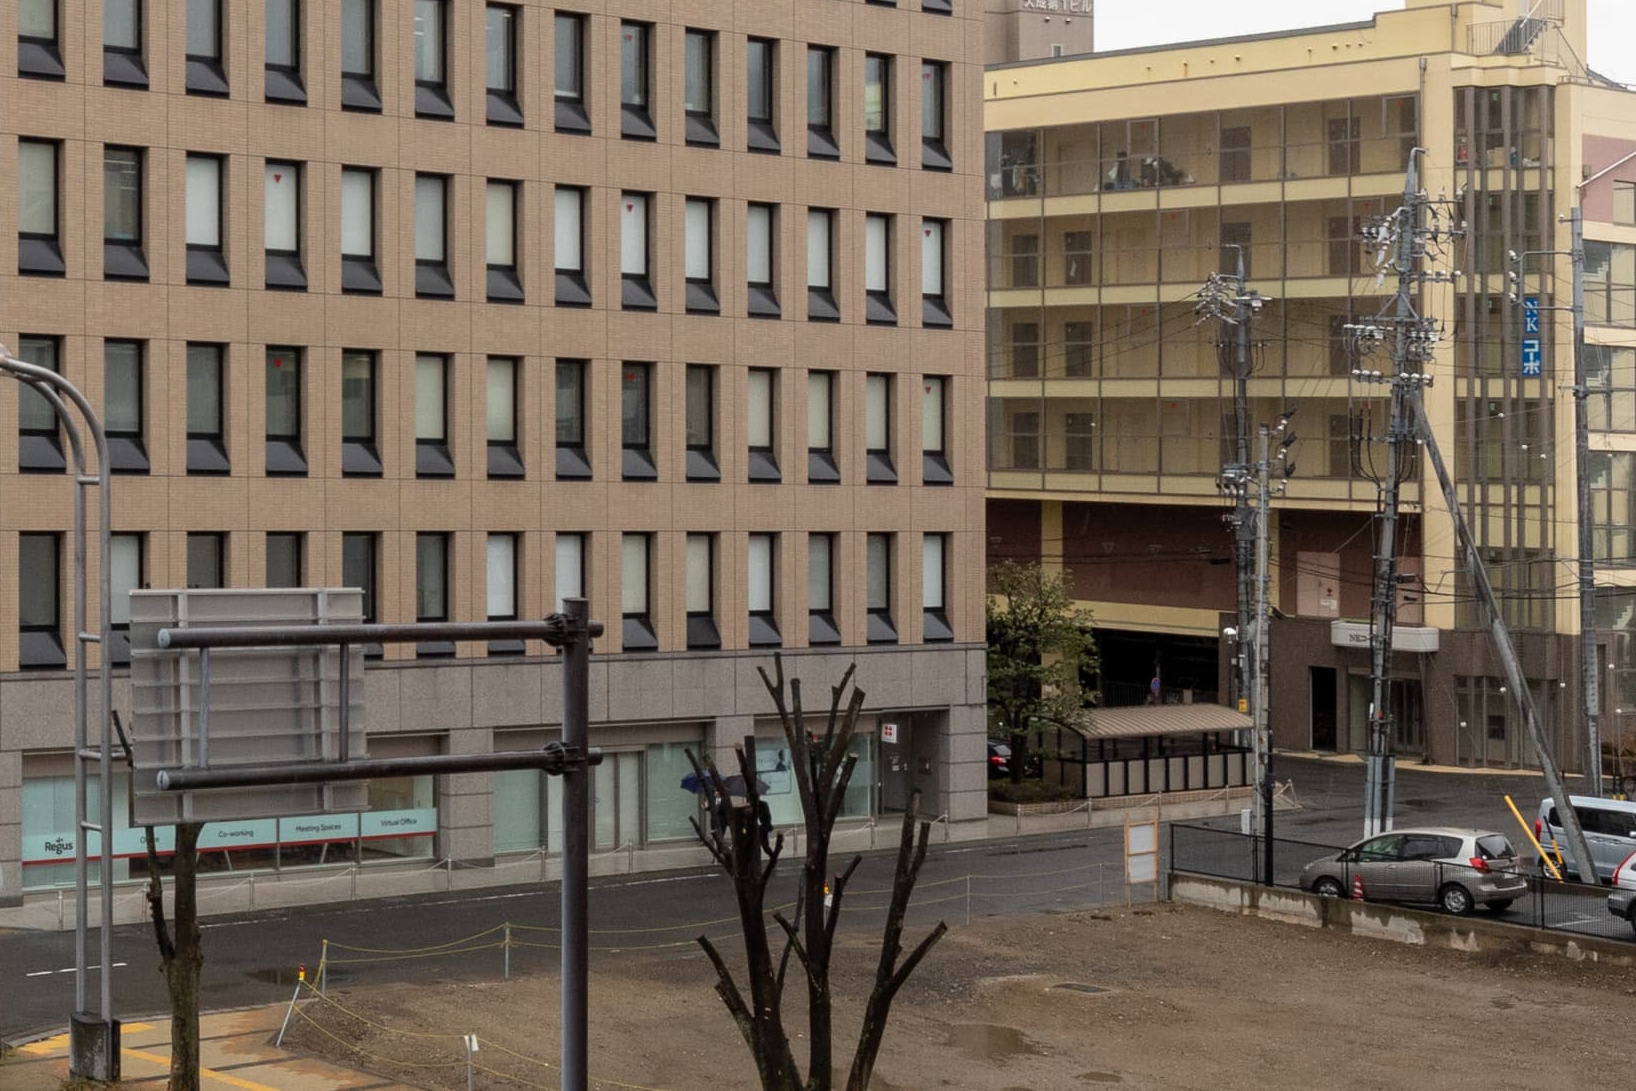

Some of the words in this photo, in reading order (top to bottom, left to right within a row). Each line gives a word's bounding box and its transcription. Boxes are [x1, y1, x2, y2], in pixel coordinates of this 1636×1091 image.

[1525, 300, 1539, 332] NK
[1523, 340, 1540, 374] コーポ
[218, 829, 254, 838] Co-working
[321, 824, 341, 832] Spaces
[45, 840, 74, 854] Regus
